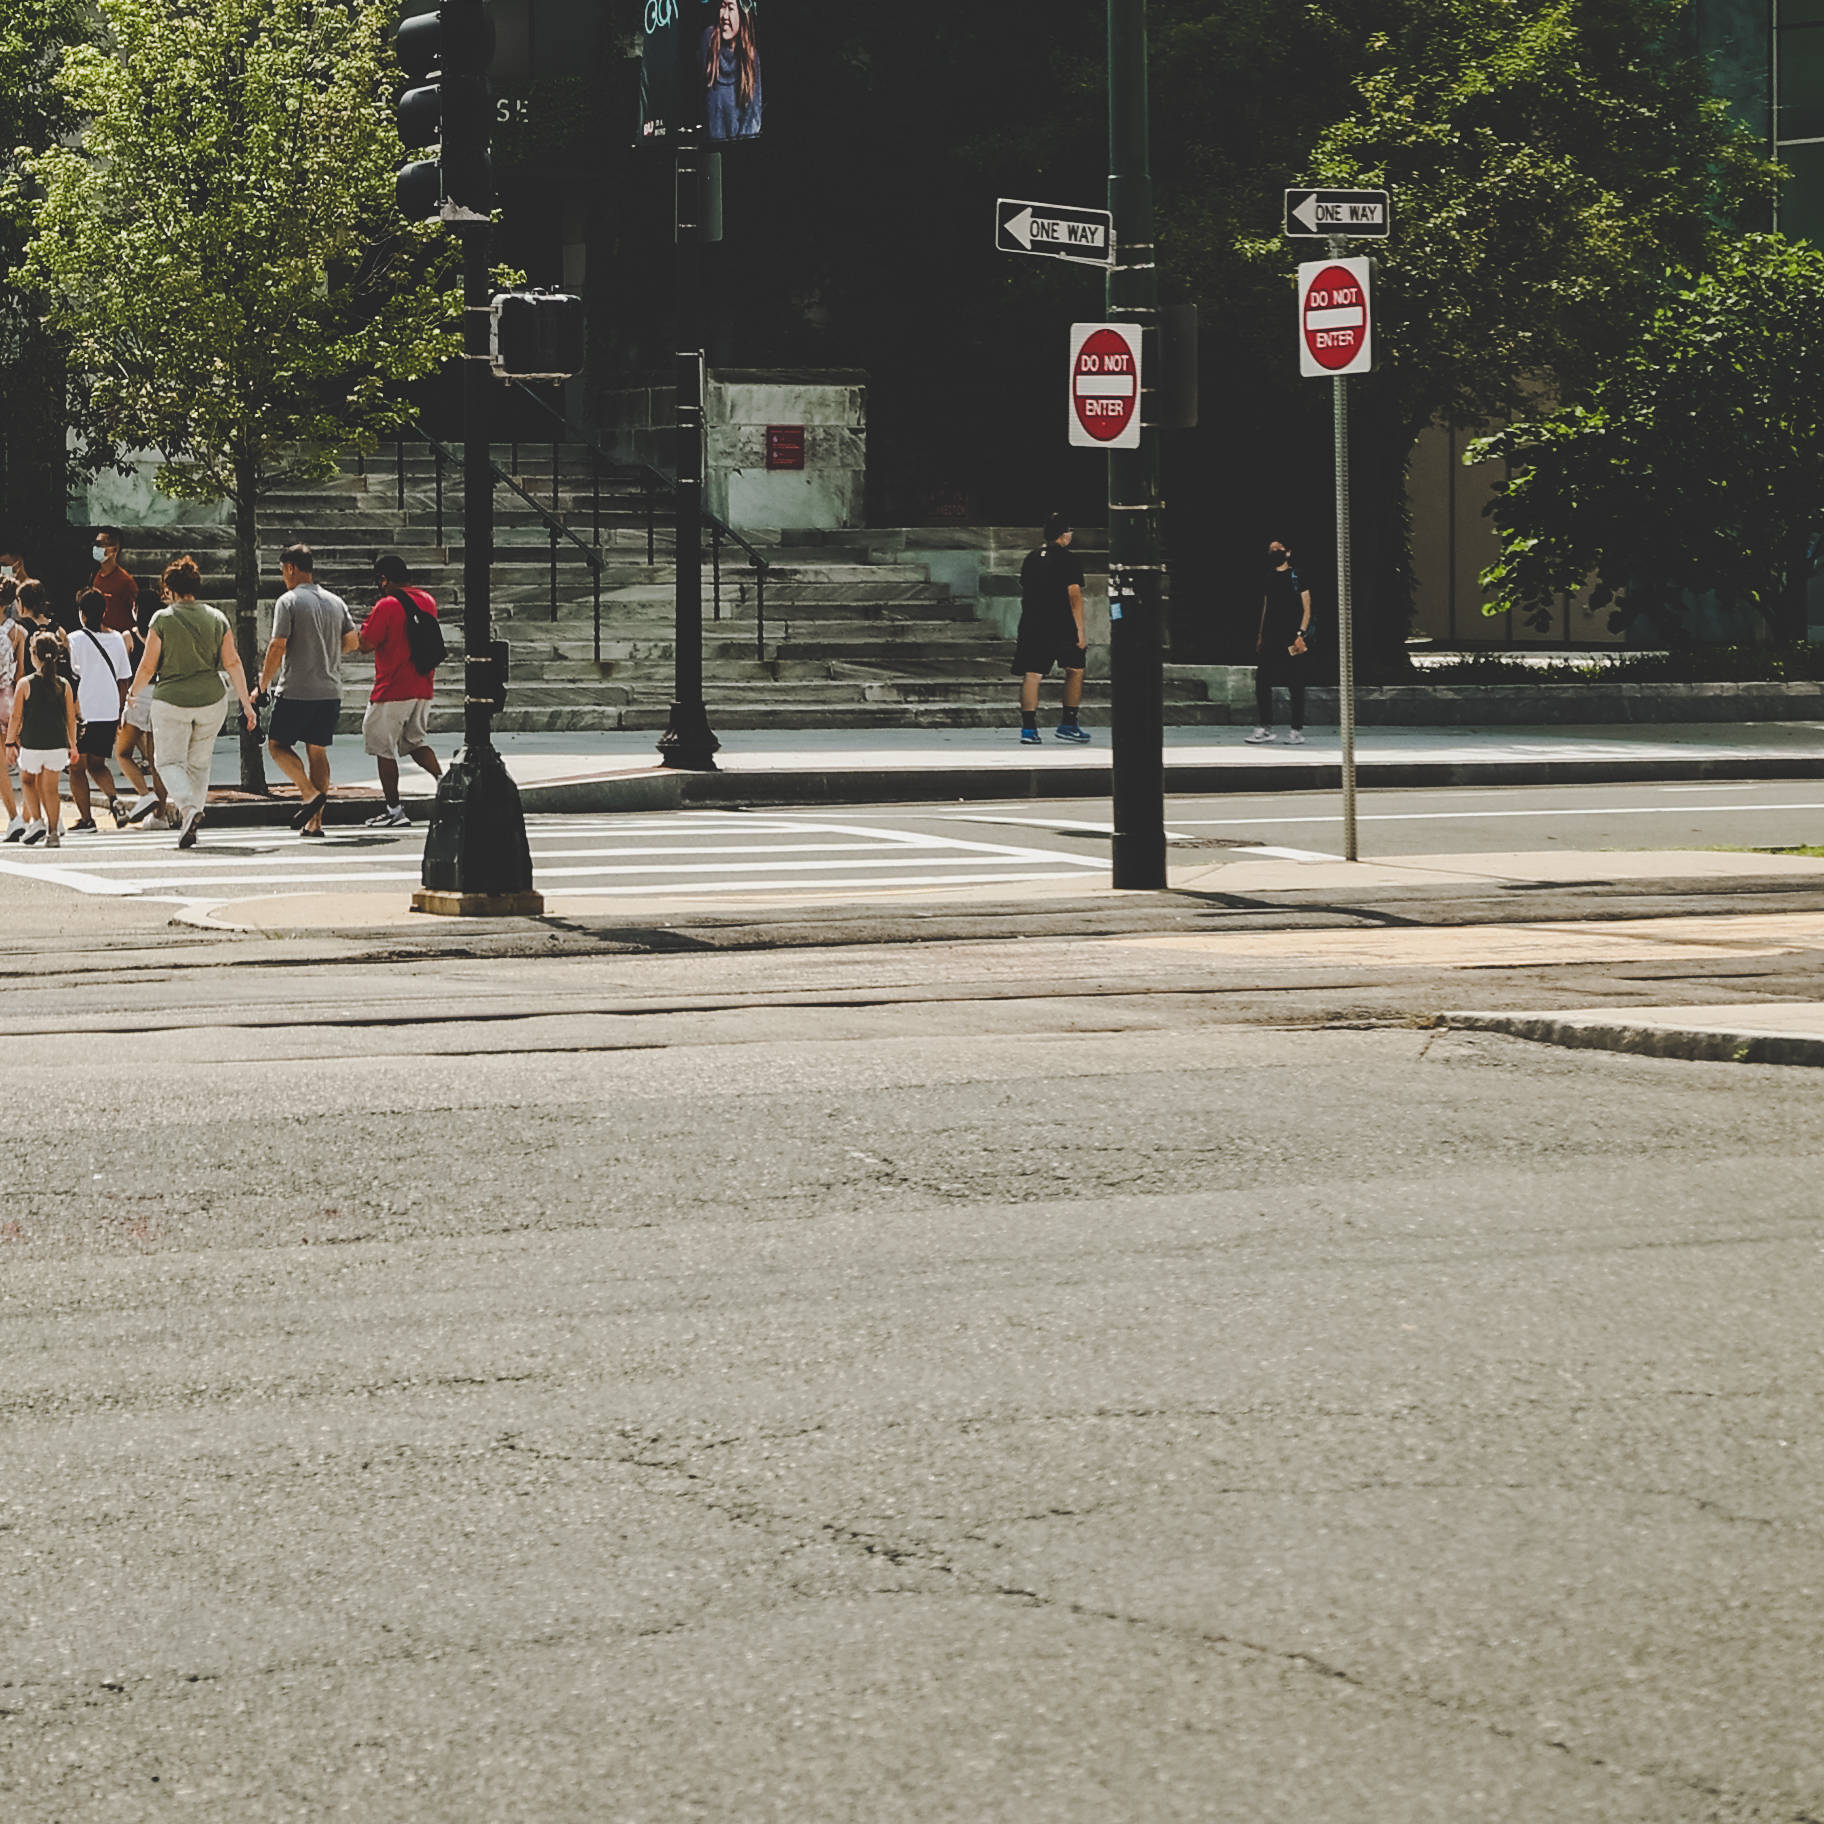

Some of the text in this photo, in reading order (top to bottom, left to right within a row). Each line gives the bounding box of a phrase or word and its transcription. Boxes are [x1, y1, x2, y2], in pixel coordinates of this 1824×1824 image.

[1316, 204, 1377, 222] ONE WAY
[1030, 219, 1099, 244] ONE WAY
[1310, 288, 1358, 307] DO NOT
[1316, 331, 1354, 348] ENTER
[1080, 354, 1129, 371] DO NOT
[1085, 399, 1123, 416] ENTER
